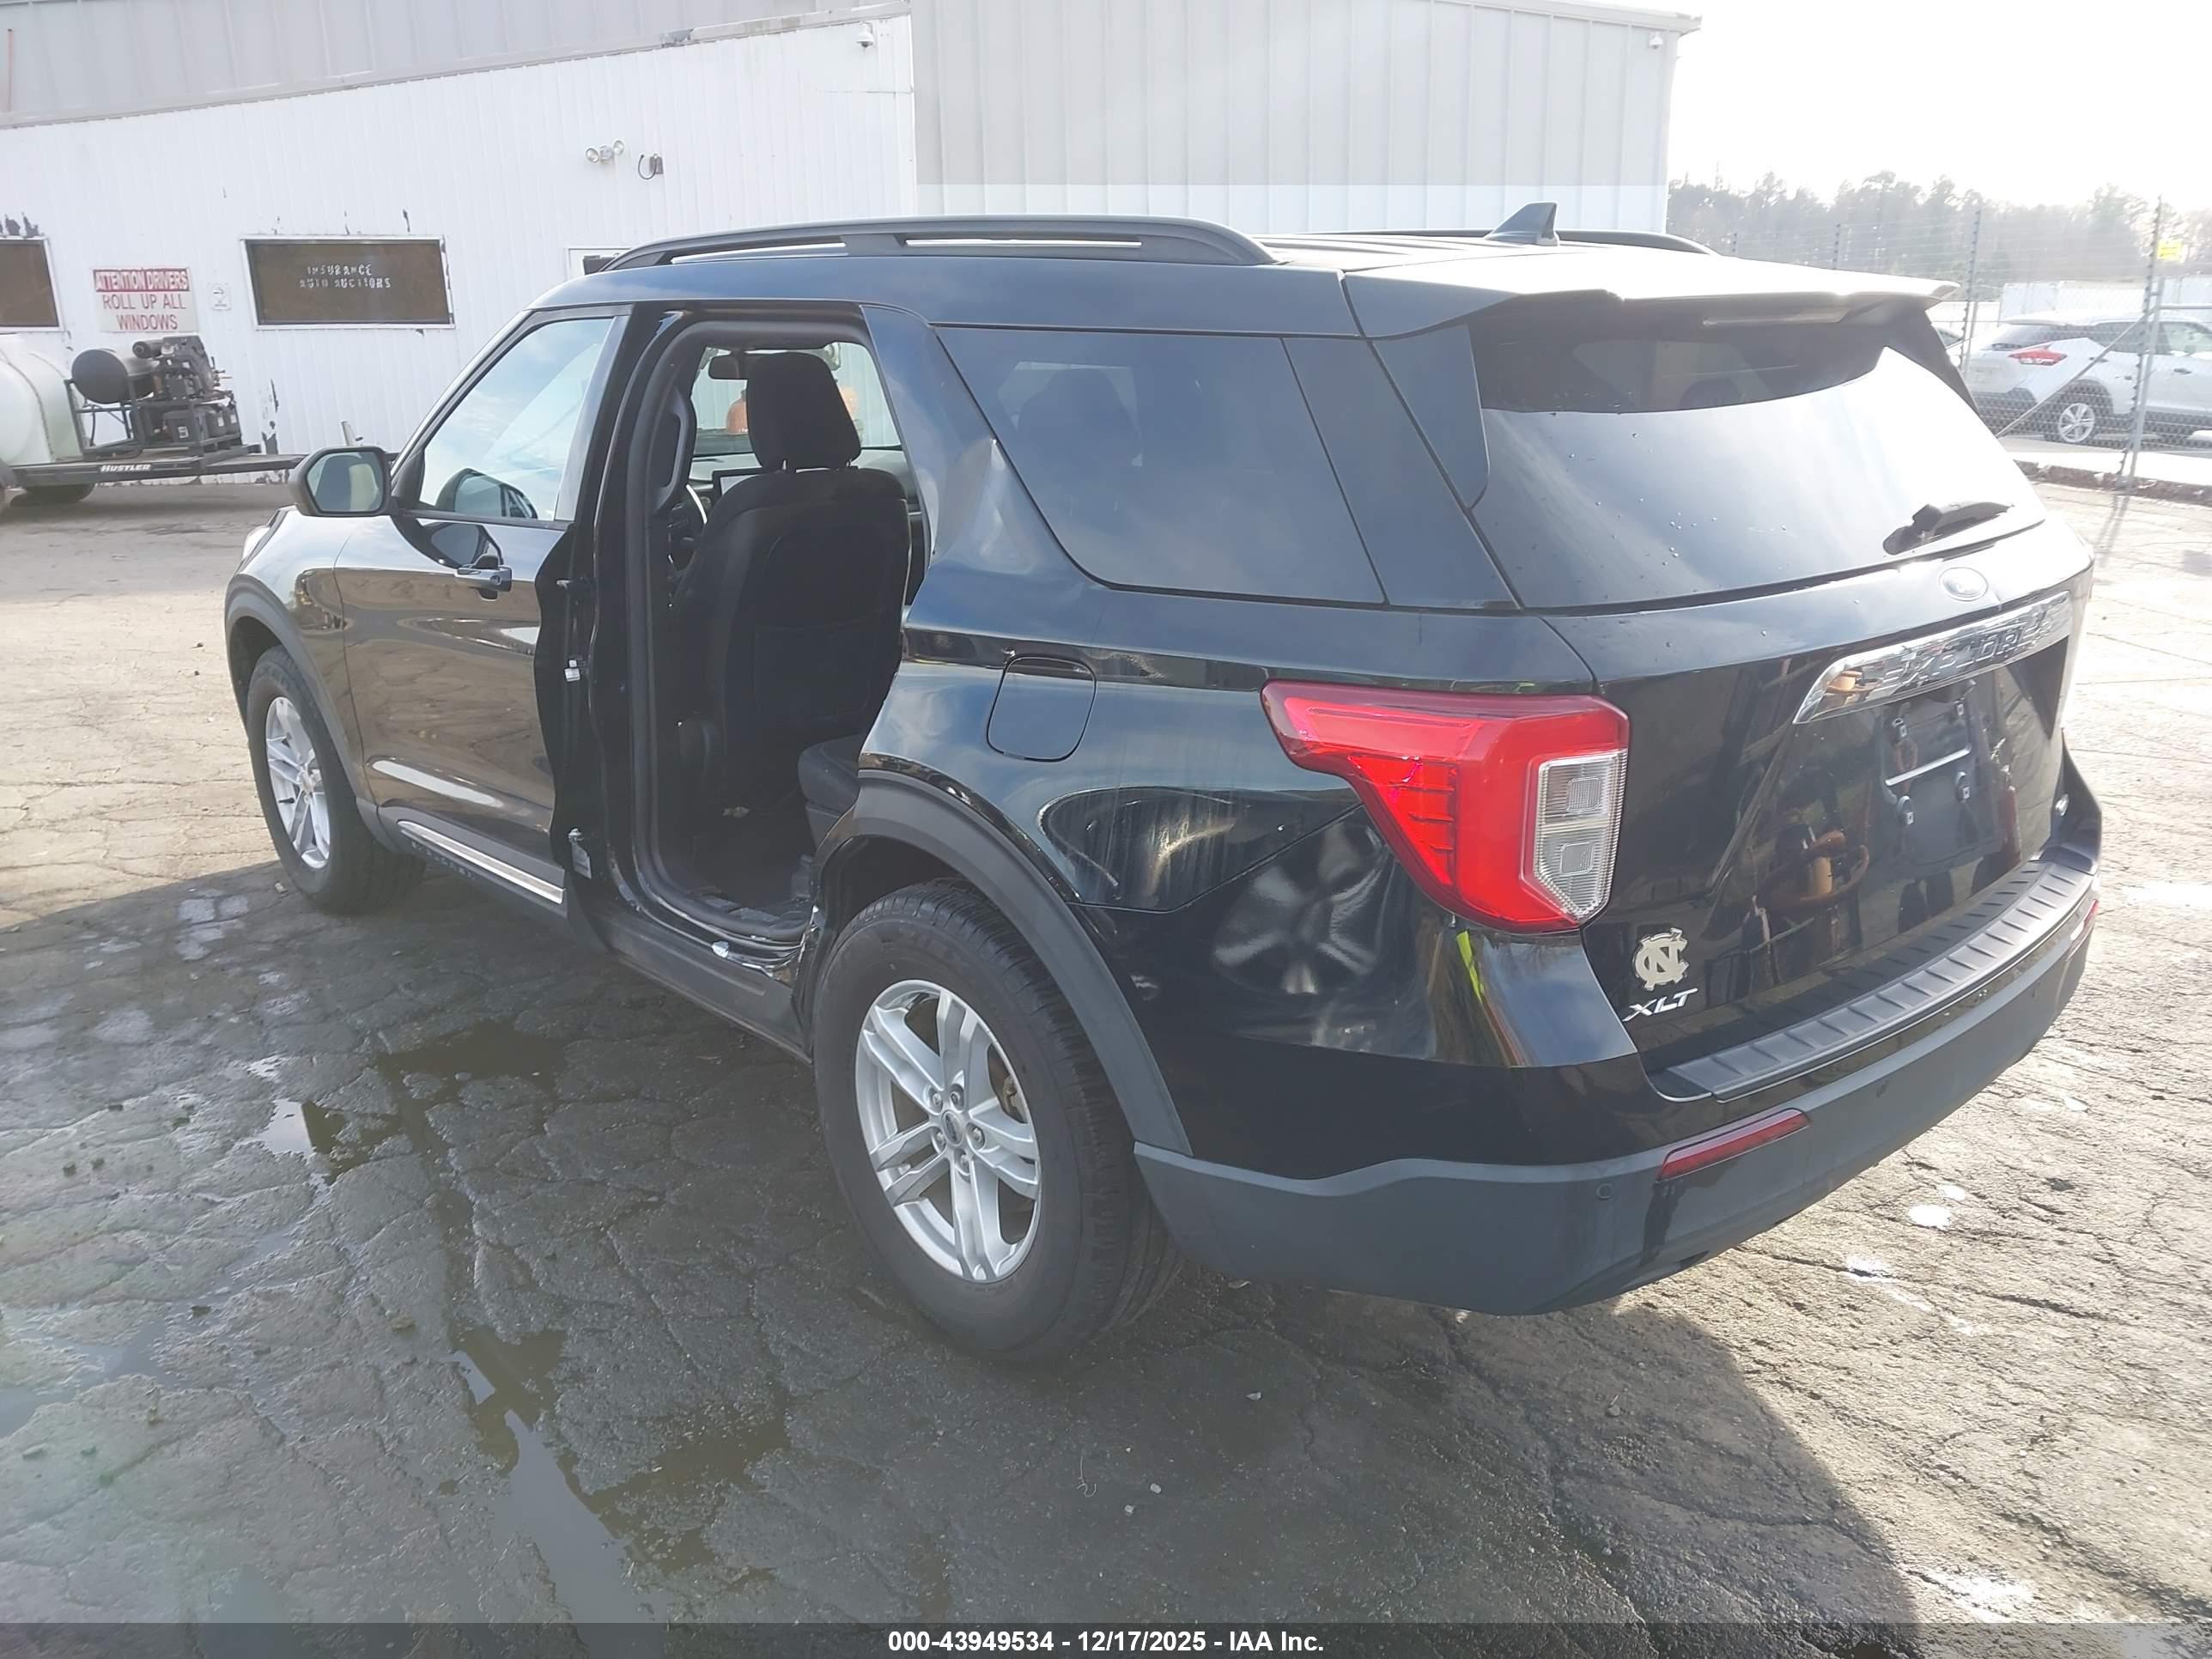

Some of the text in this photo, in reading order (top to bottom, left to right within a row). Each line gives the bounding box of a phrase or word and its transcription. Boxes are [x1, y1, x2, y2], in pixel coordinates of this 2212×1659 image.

[307, 264, 372, 276] INSURANCE
[95, 270, 188, 290] ATTENTION DRIVERS
[103, 293, 186, 310] ROLL UP ALL
[117, 313, 178, 331] WINDOWS
[100, 464, 151, 472] HUSTLER
[1622, 988, 1698, 1022] XLT
